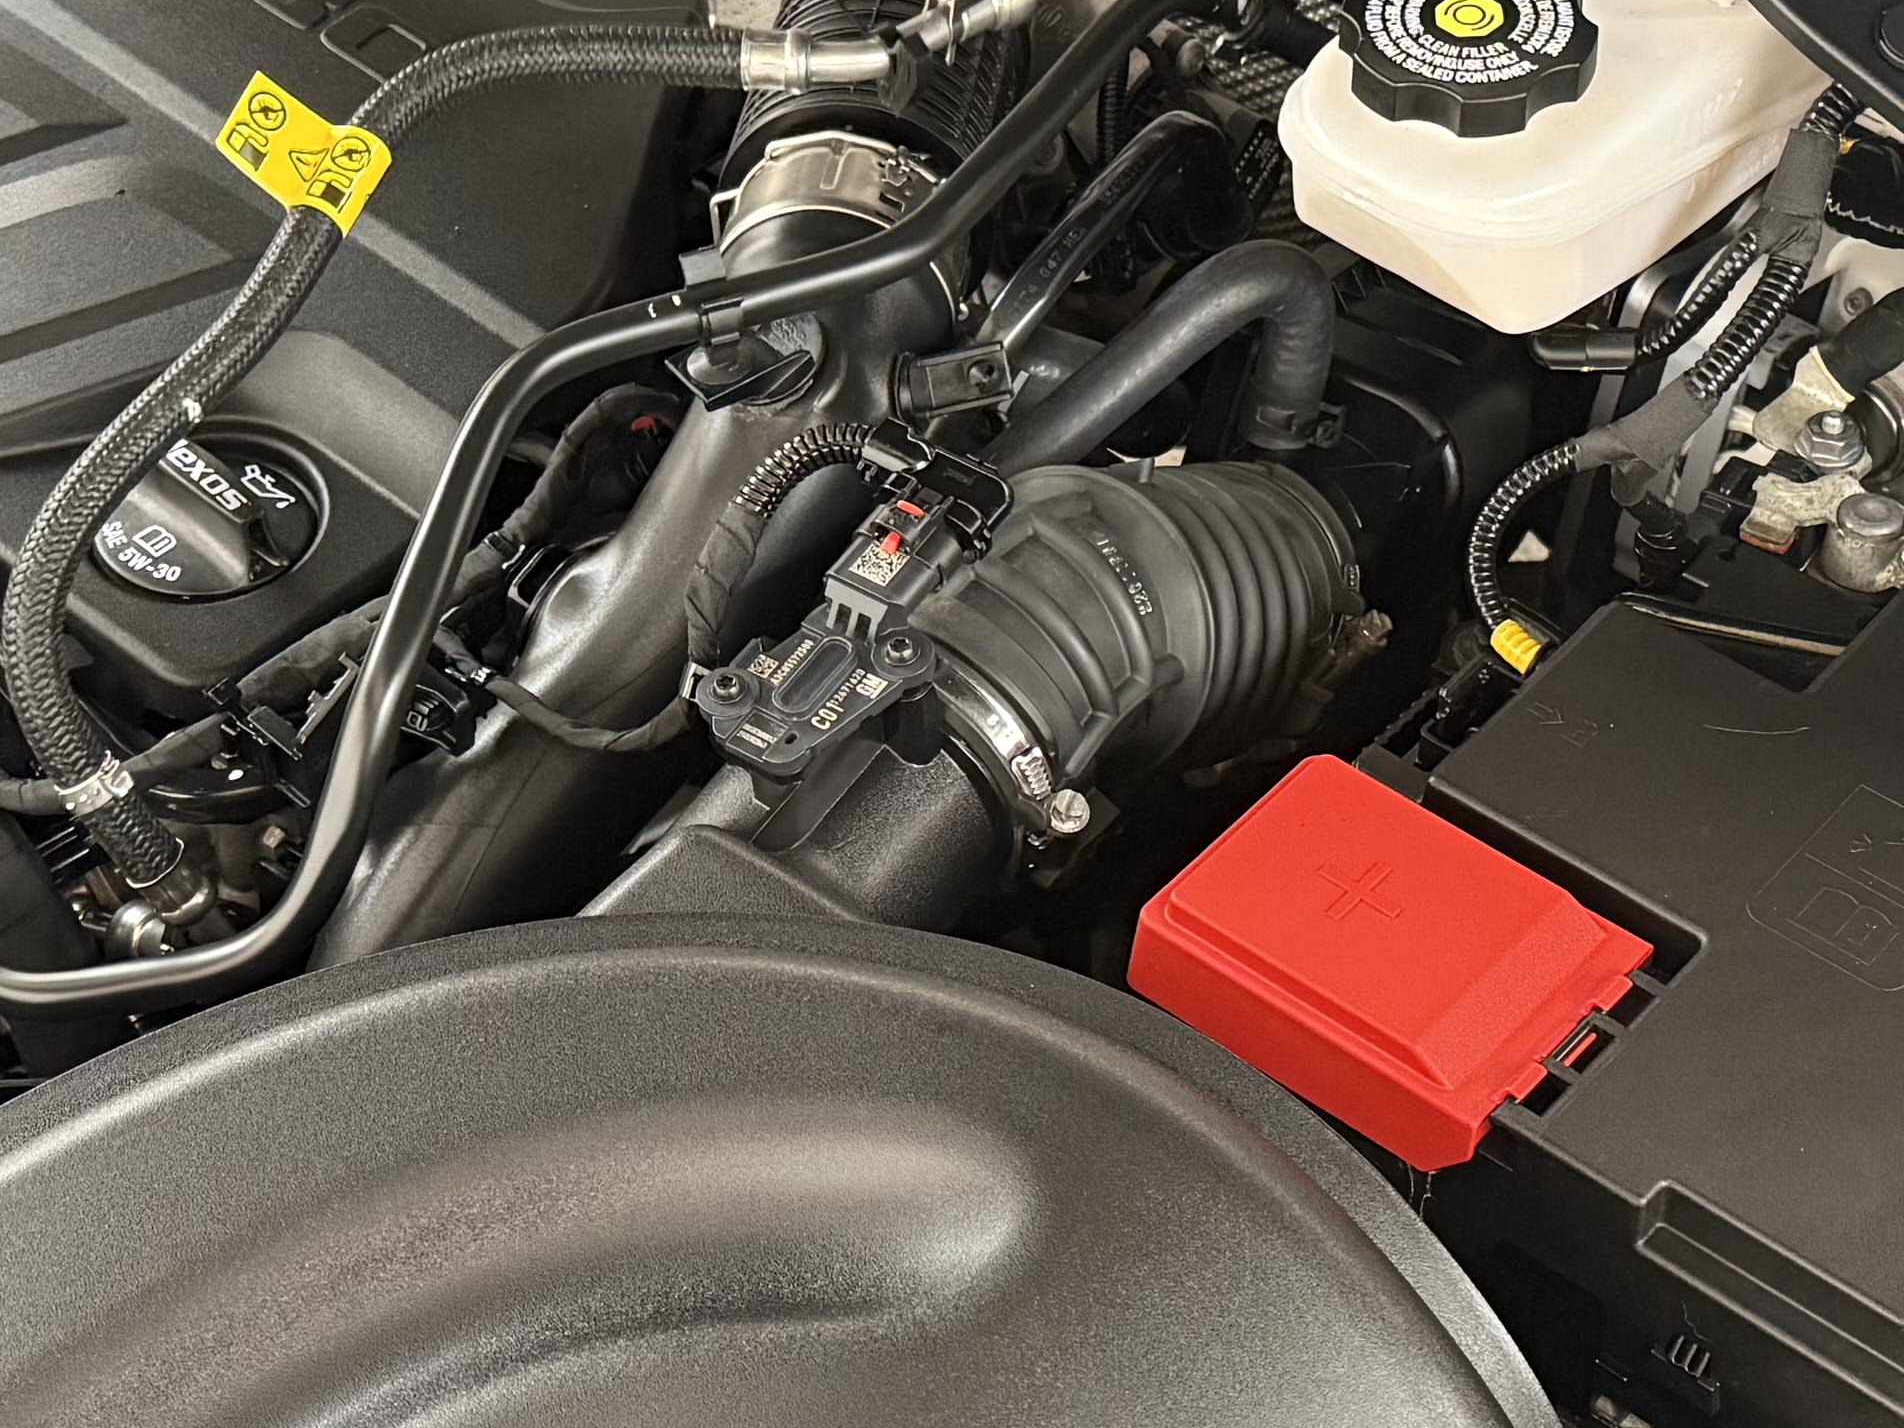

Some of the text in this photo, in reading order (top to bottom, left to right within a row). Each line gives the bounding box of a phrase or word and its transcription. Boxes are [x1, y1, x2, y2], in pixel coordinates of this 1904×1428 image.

[1365, 5, 1384, 31] FLUID
[1368, 30, 1402, 58] FROM
[1416, 33, 1460, 56] CLEAN
[1461, 41, 1510, 57] FILLER
[1400, 57, 1454, 82] SEALED
[1456, 59, 1486, 70] USE
[1484, 50, 1522, 68] ONLY
[102, 521, 182, 582] SAE 5W-30
[854, 673, 889, 699] GM
